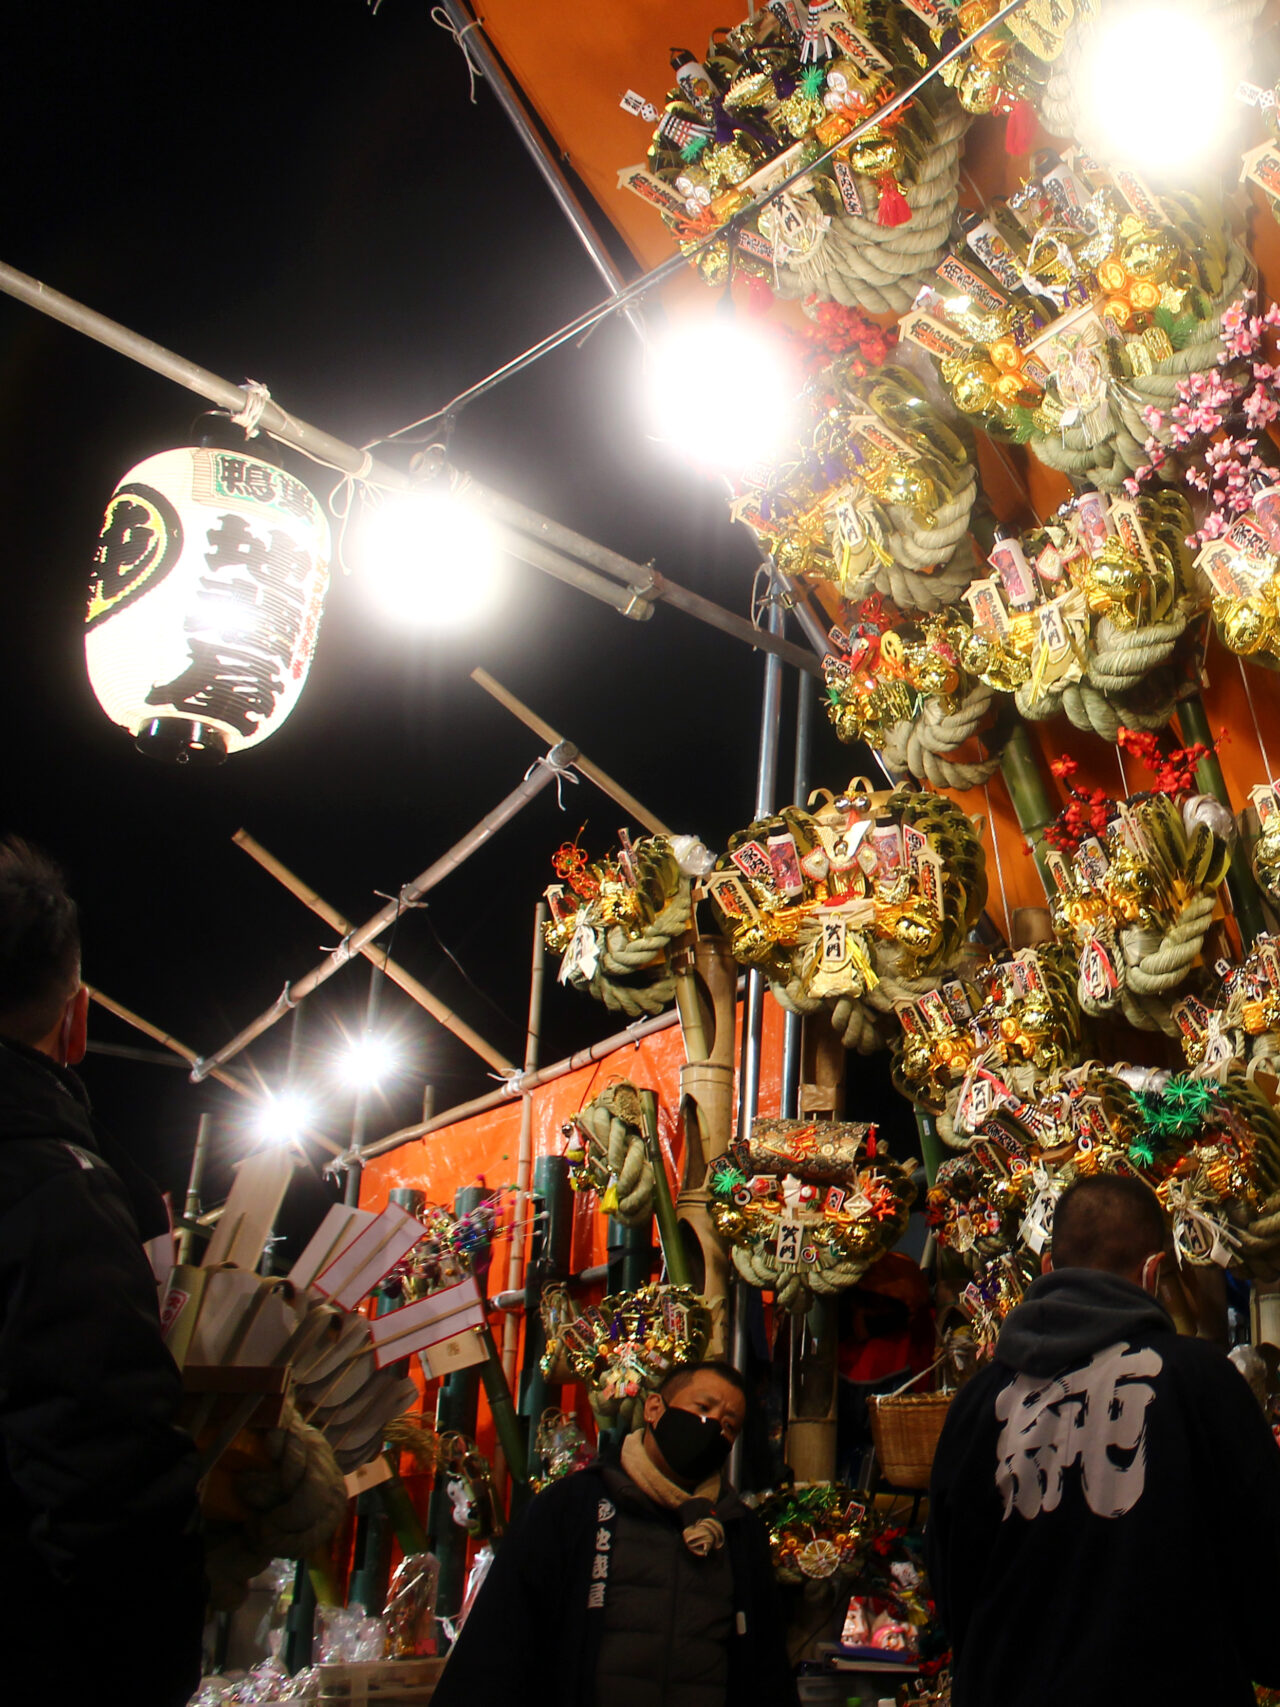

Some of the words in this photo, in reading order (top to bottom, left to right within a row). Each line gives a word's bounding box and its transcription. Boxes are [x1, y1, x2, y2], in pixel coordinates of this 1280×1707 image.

[942, 259, 1004, 310] 商売繁昌
[825, 924, 842, 959] 笑門
[779, 1224, 799, 1261] 笑門
